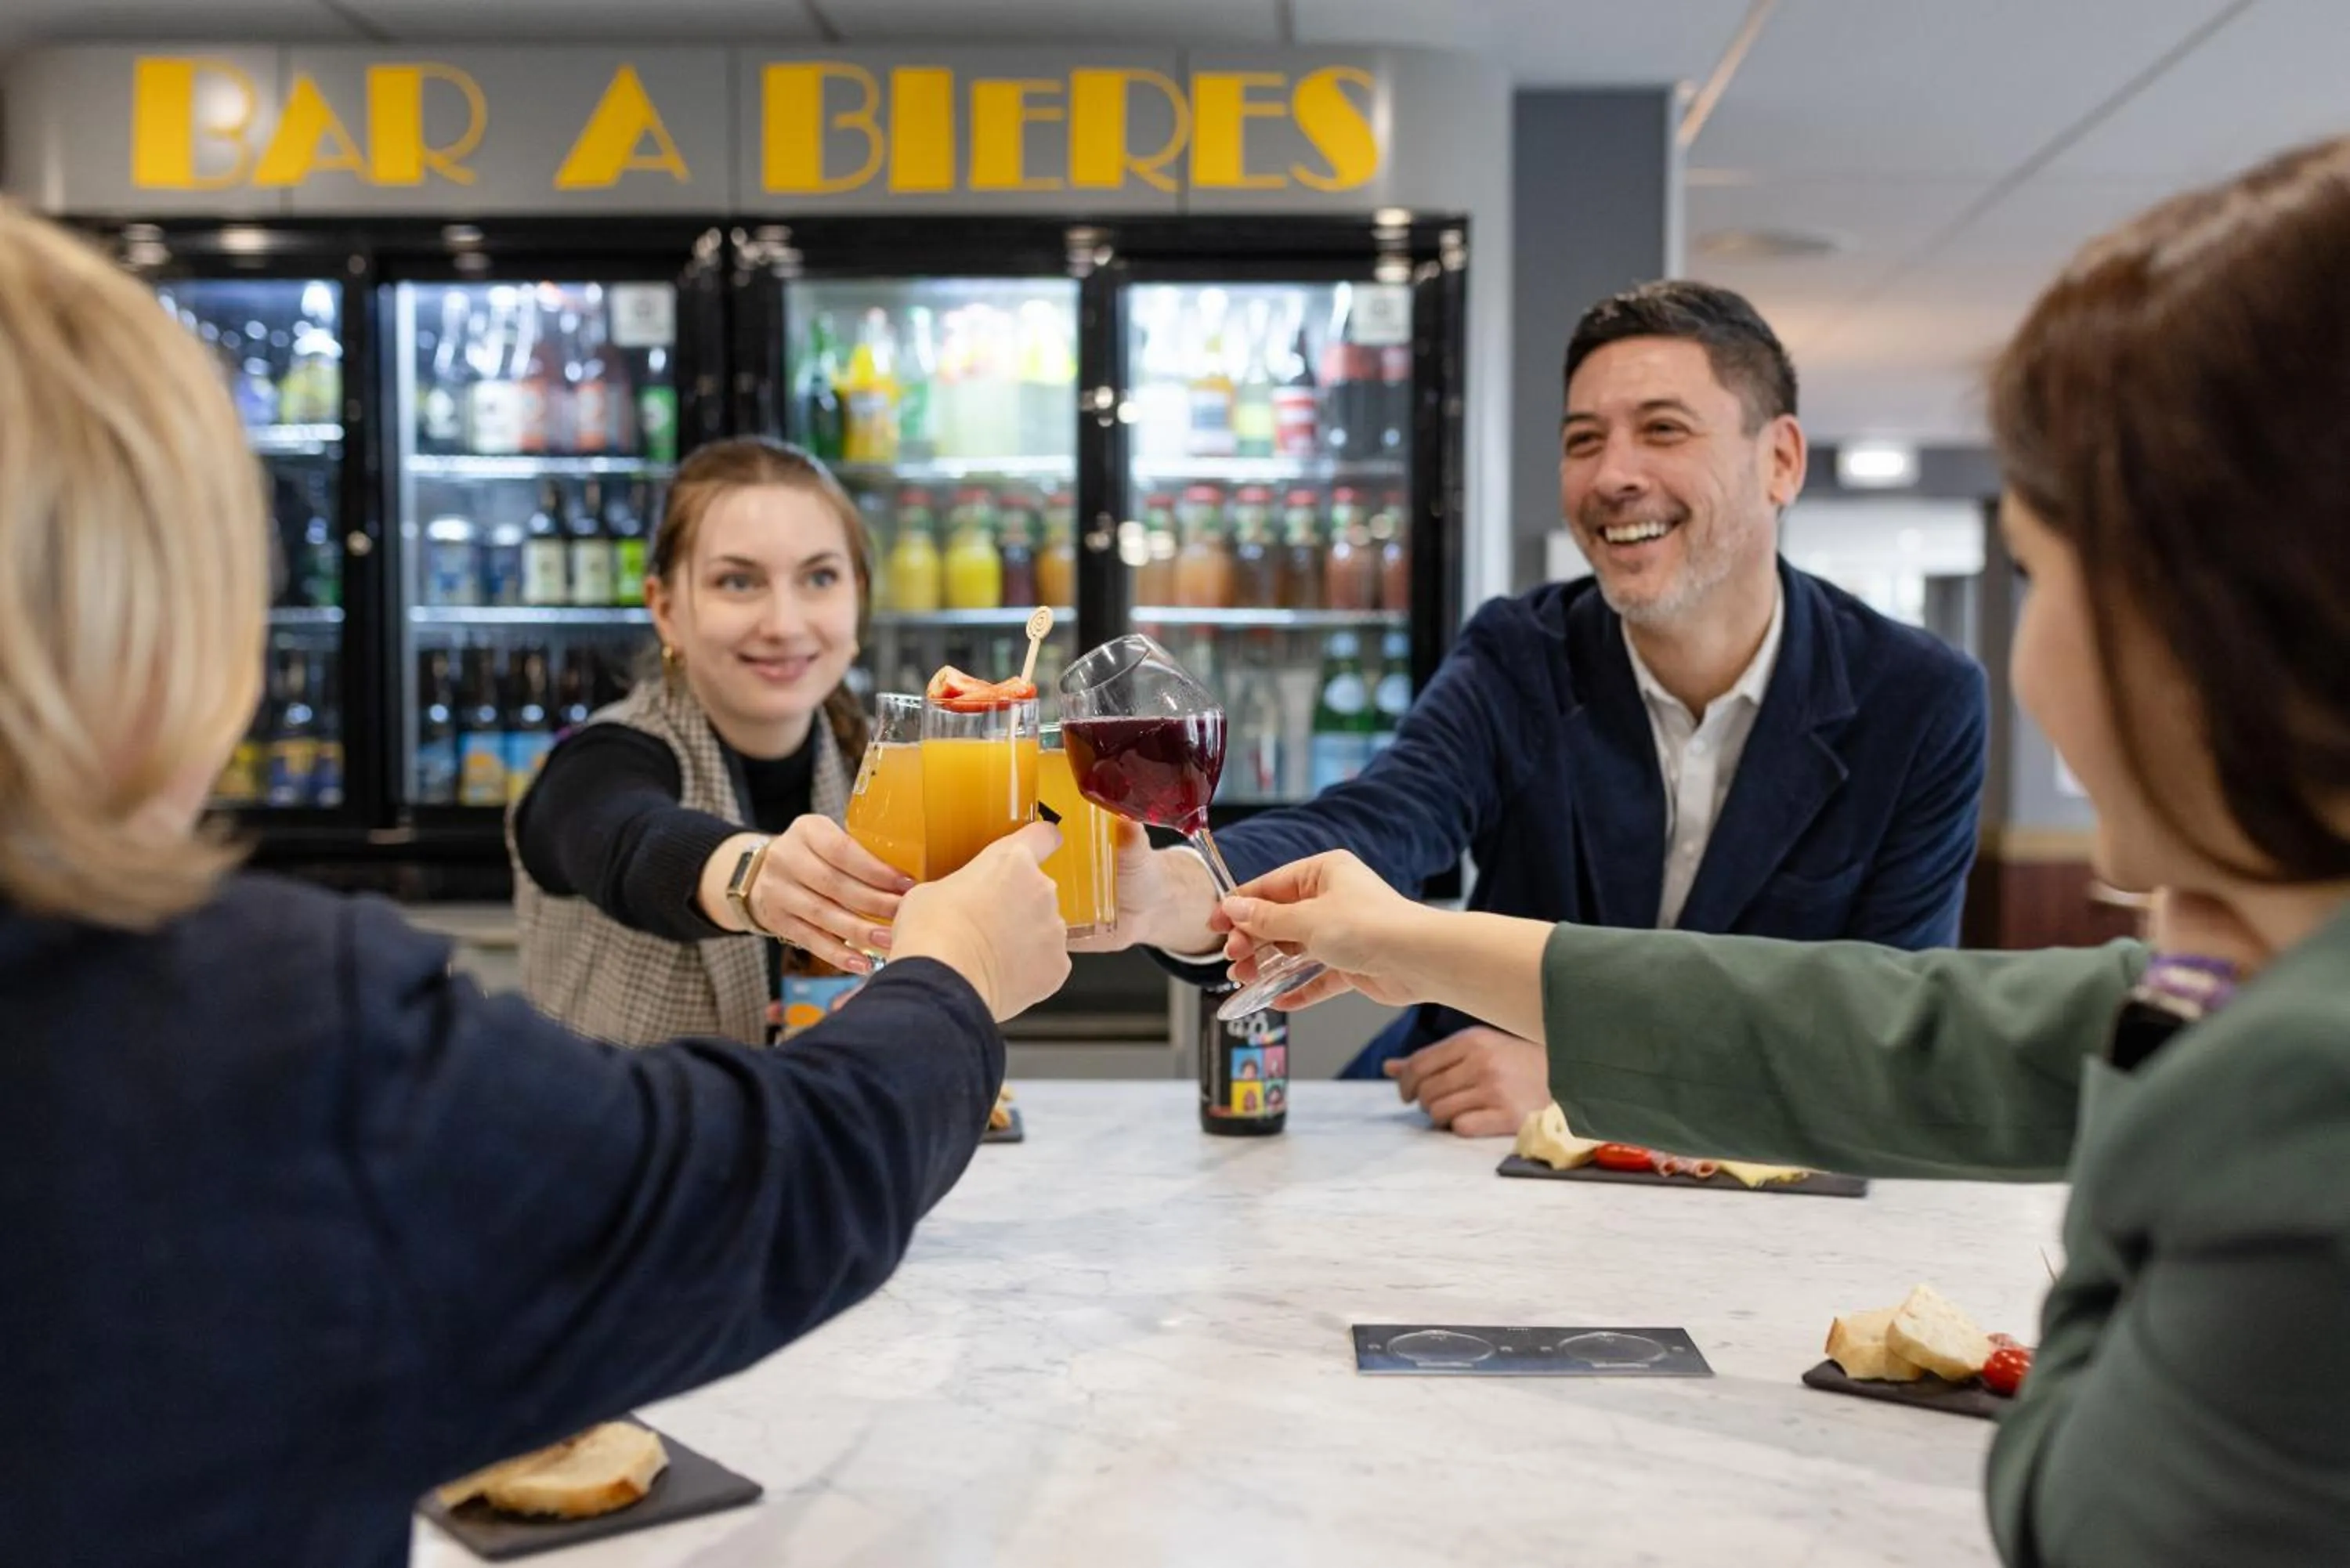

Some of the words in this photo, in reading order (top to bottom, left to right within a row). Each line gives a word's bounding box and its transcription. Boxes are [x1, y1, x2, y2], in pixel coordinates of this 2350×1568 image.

[129, 55, 486, 191] BAR
[552, 63, 689, 192] A
[759, 60, 1380, 196] BIERES
